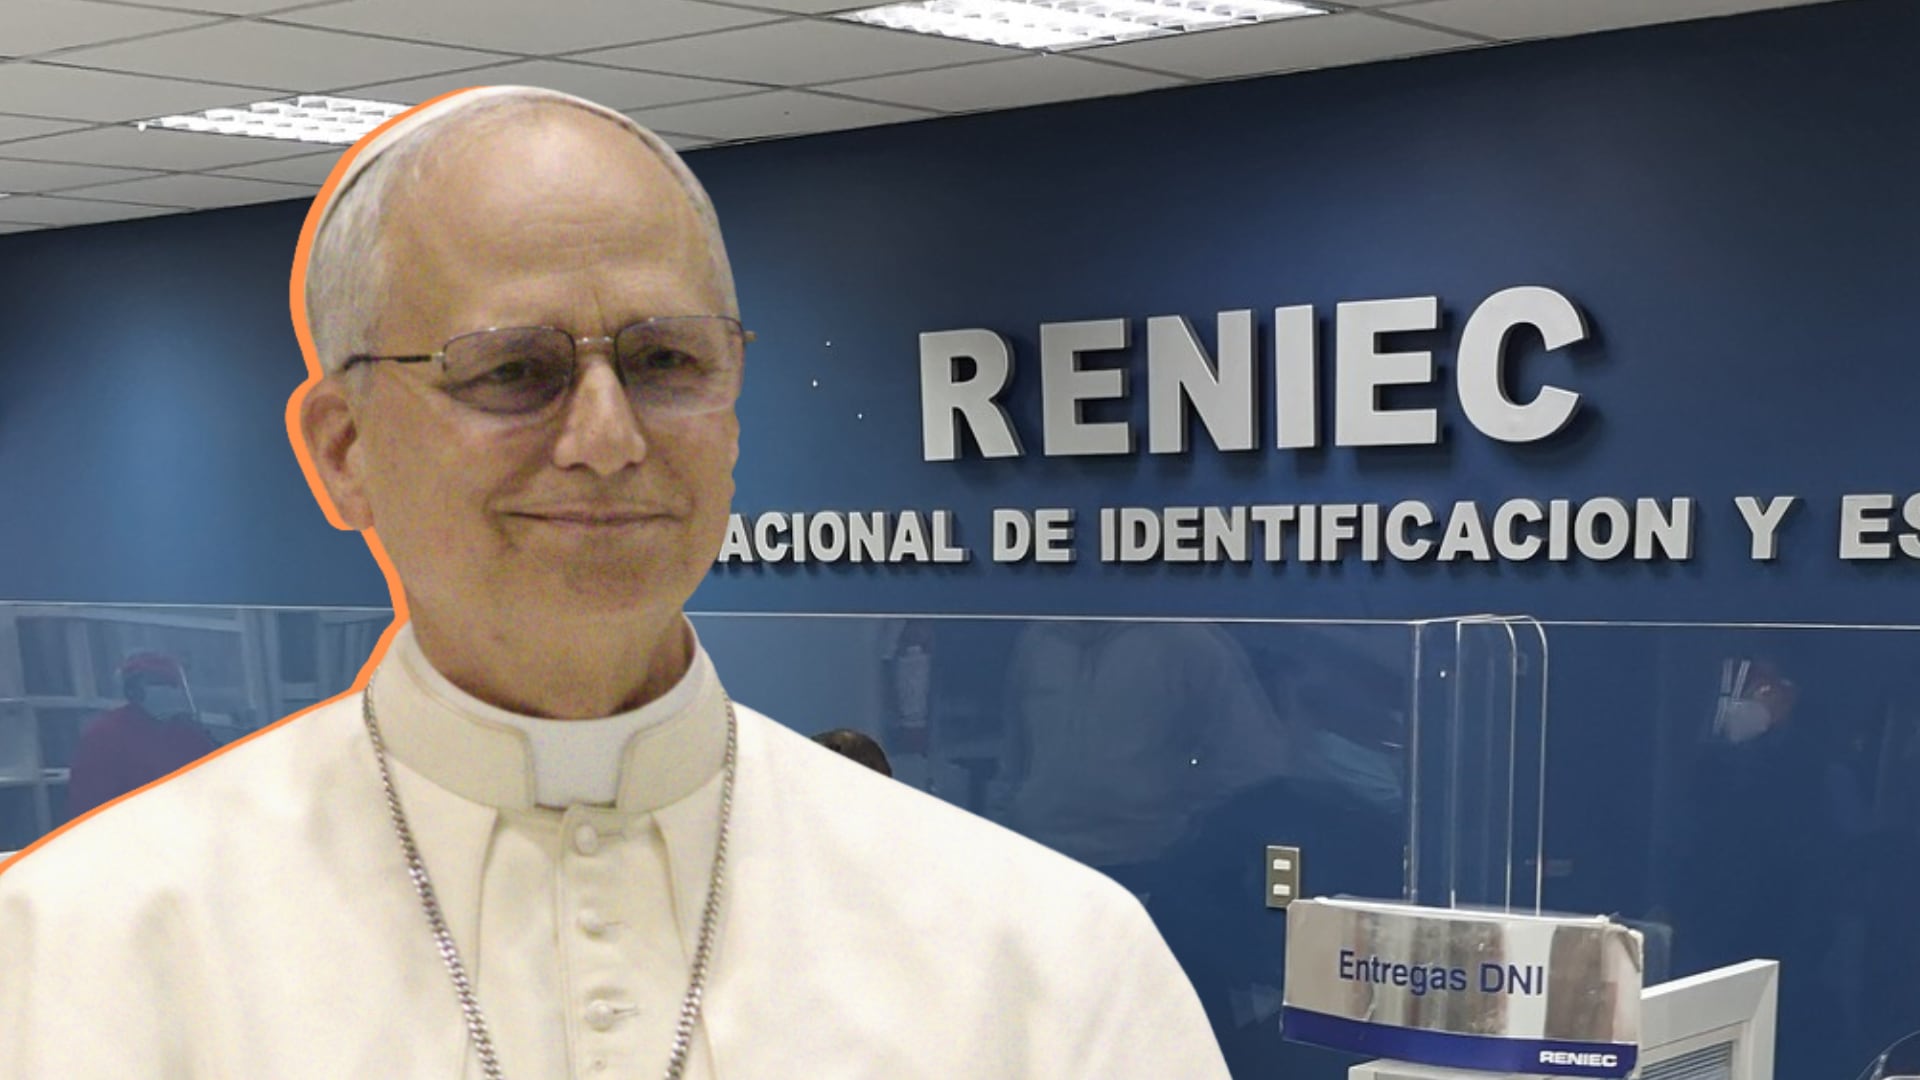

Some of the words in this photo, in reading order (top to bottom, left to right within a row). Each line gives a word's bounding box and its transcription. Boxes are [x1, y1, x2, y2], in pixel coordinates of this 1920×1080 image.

[920, 286, 1587, 461] RENIEC
[993, 509, 1075, 561] DE
[1101, 497, 1691, 562] IDENTIFICACION
[1735, 496, 1795, 559] Y
[1339, 950, 1467, 995] Entregas
[1480, 963, 1544, 995] DNI
[1539, 1050, 1618, 1067] RENIEC
